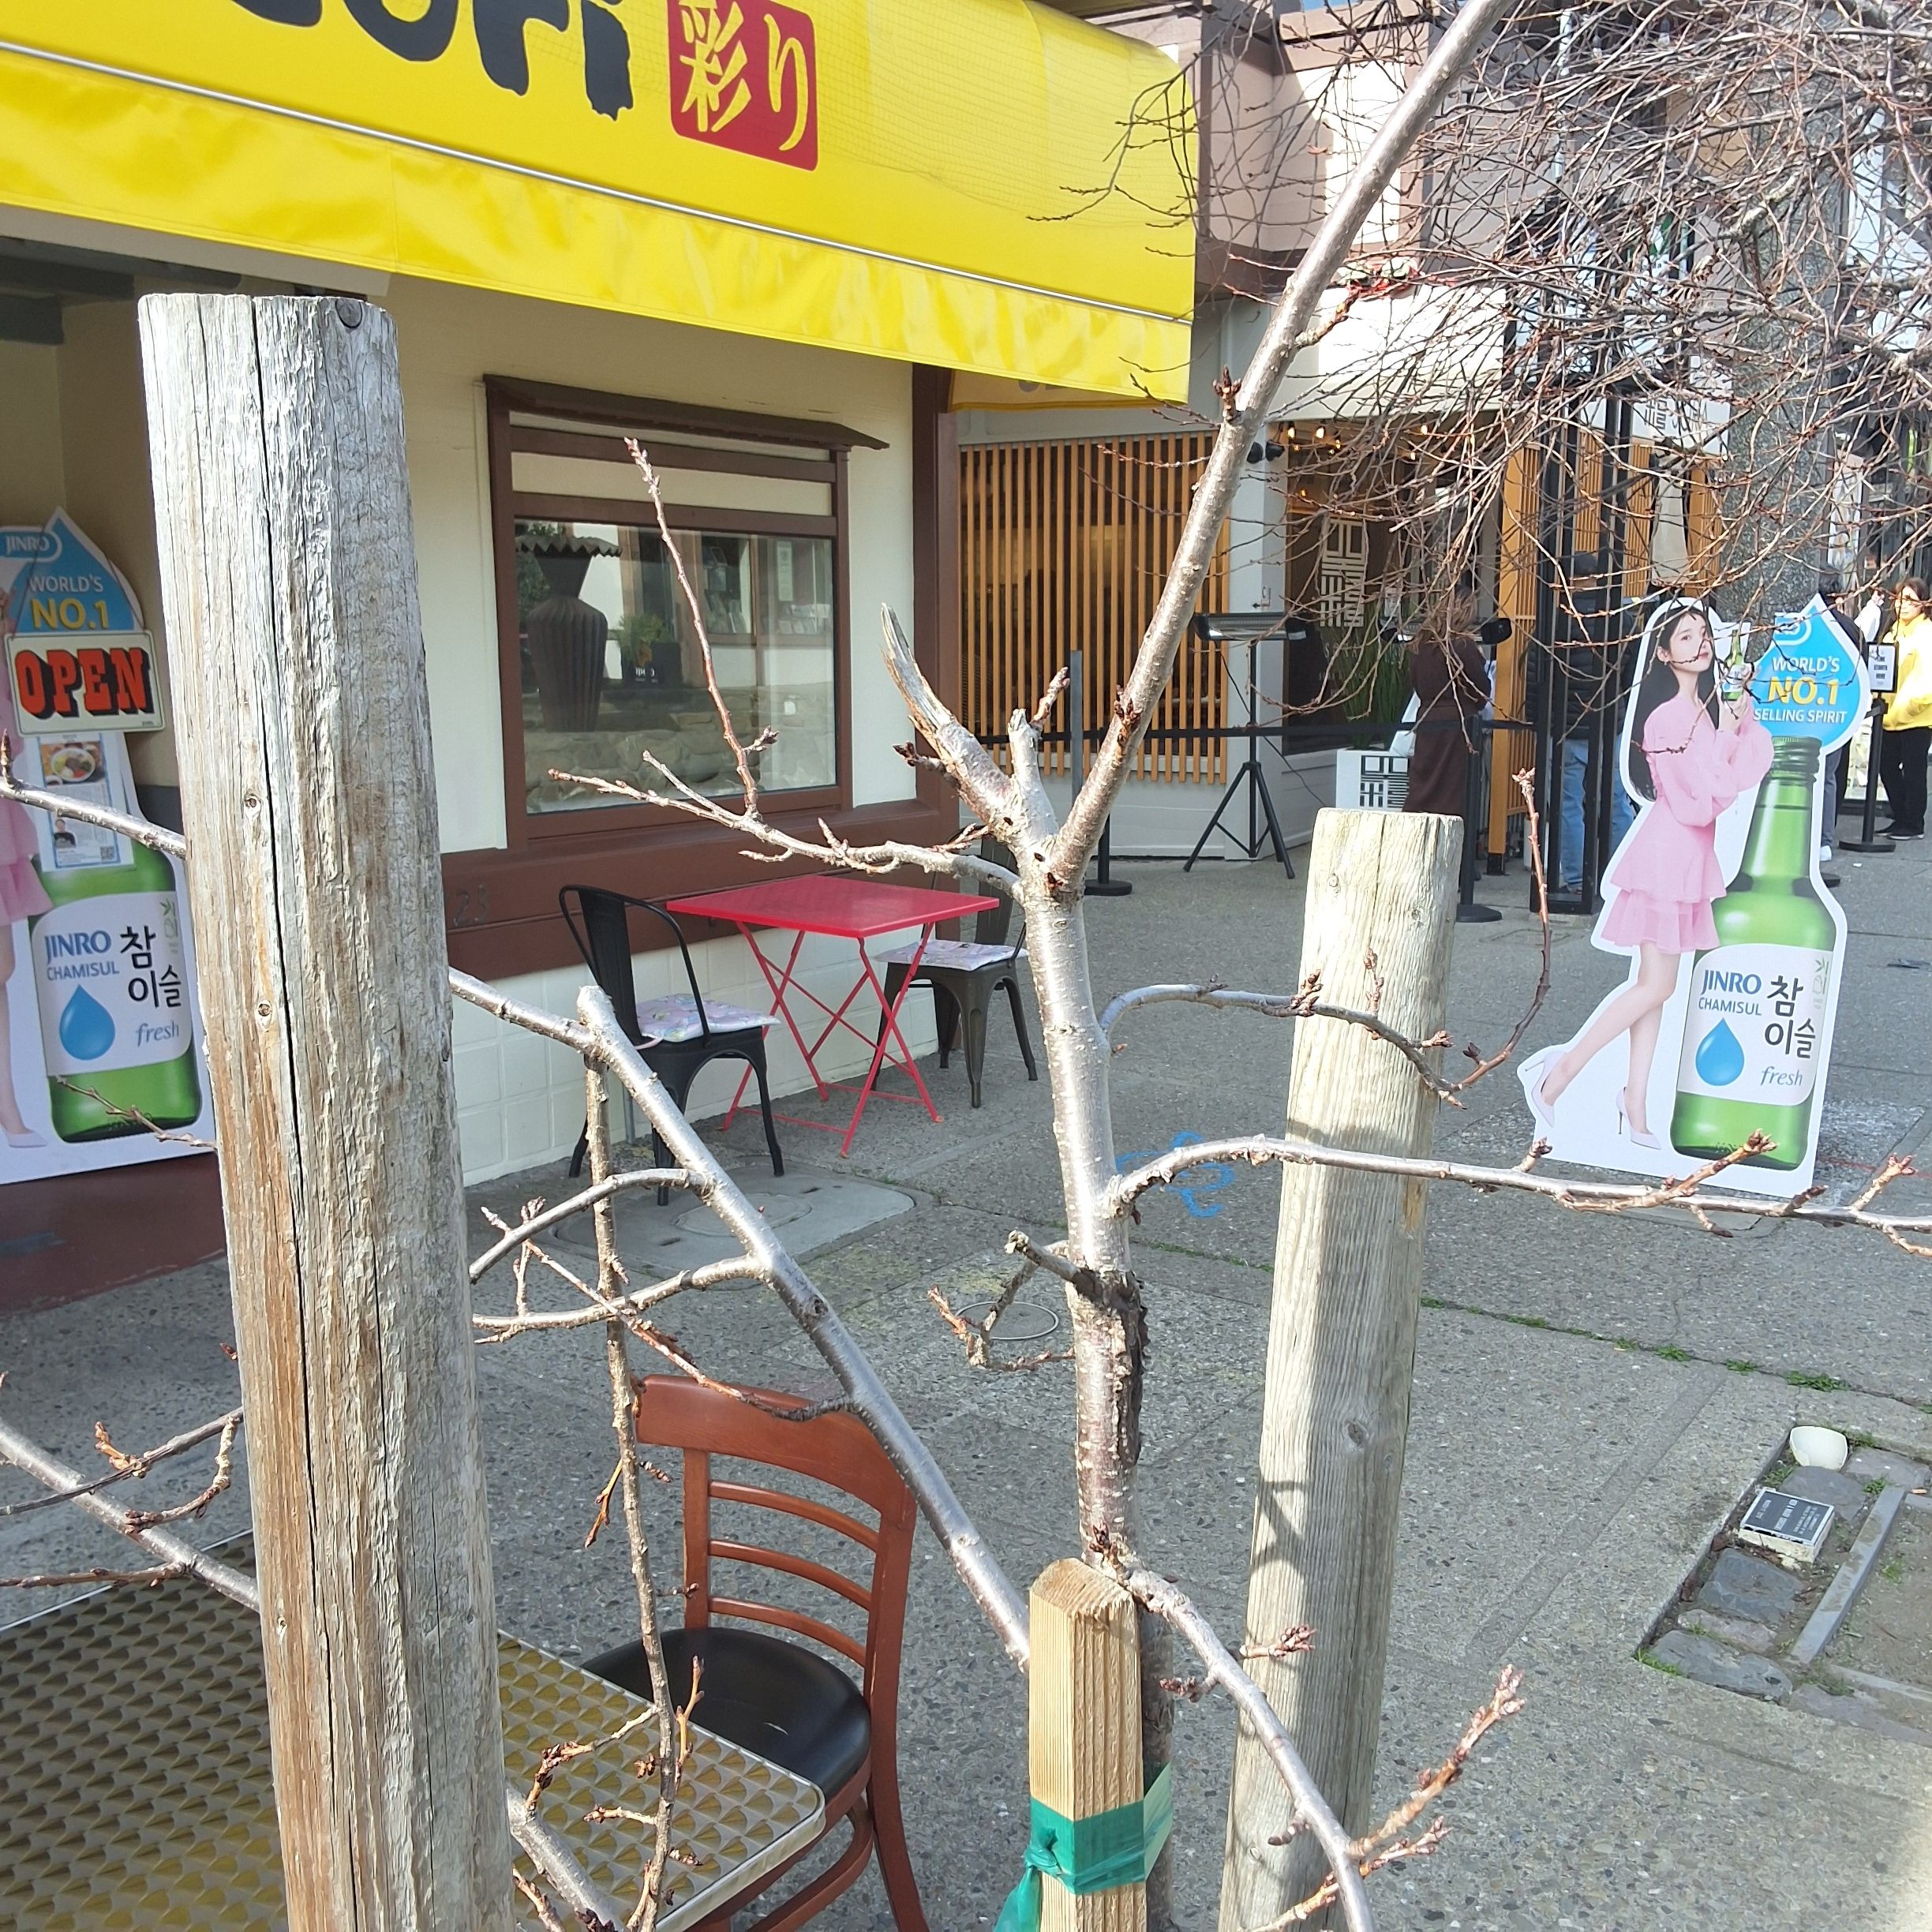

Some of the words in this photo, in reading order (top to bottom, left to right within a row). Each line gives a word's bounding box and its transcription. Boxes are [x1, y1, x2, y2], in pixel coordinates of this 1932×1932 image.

[6, 535, 50, 556] JINRO
[29, 575, 104, 593] WORLD'S
[31, 597, 110, 631] NO.1
[1772, 655, 1840, 673] WORLD'S
[14, 647, 155, 720] OPEN
[1768, 676, 1840, 706] NO.1
[1754, 708, 1805, 723] SELLING
[1807, 710, 1848, 724] SPIRIT
[43, 929, 112, 966] JINRO
[120, 925, 157, 970] 참
[47, 959, 120, 981] CHAMISUL
[1700, 969, 1763, 996] JINRO
[127, 964, 182, 1009] 이슬
[1766, 974, 1804, 1018] 참
[1698, 996, 1762, 1017] CHAMISUL
[134, 1022, 180, 1048] fresh
[1764, 1017, 1817, 1059] 이슬
[1759, 1065, 1804, 1088] fresh
